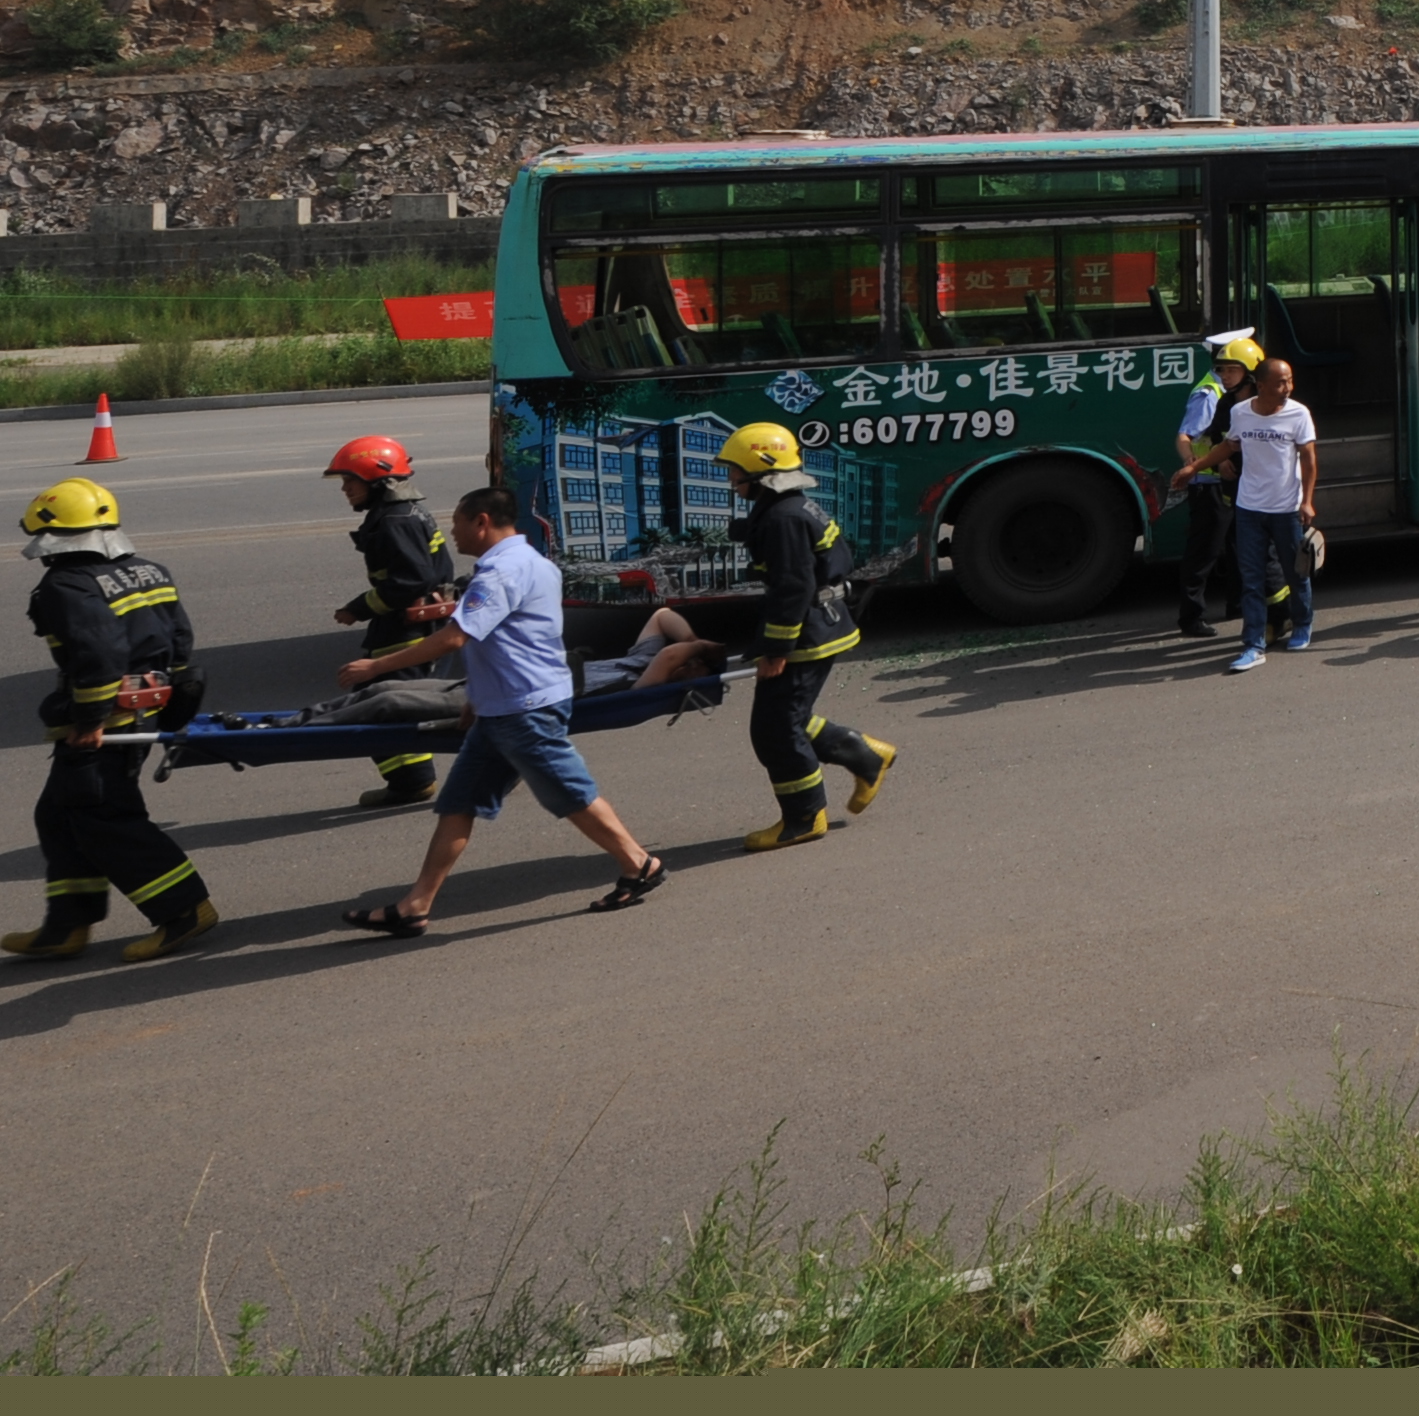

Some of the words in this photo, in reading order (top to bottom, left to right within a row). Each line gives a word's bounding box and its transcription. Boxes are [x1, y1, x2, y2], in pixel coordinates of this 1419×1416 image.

[833, 347, 1195, 408] 金地·佳景花园
